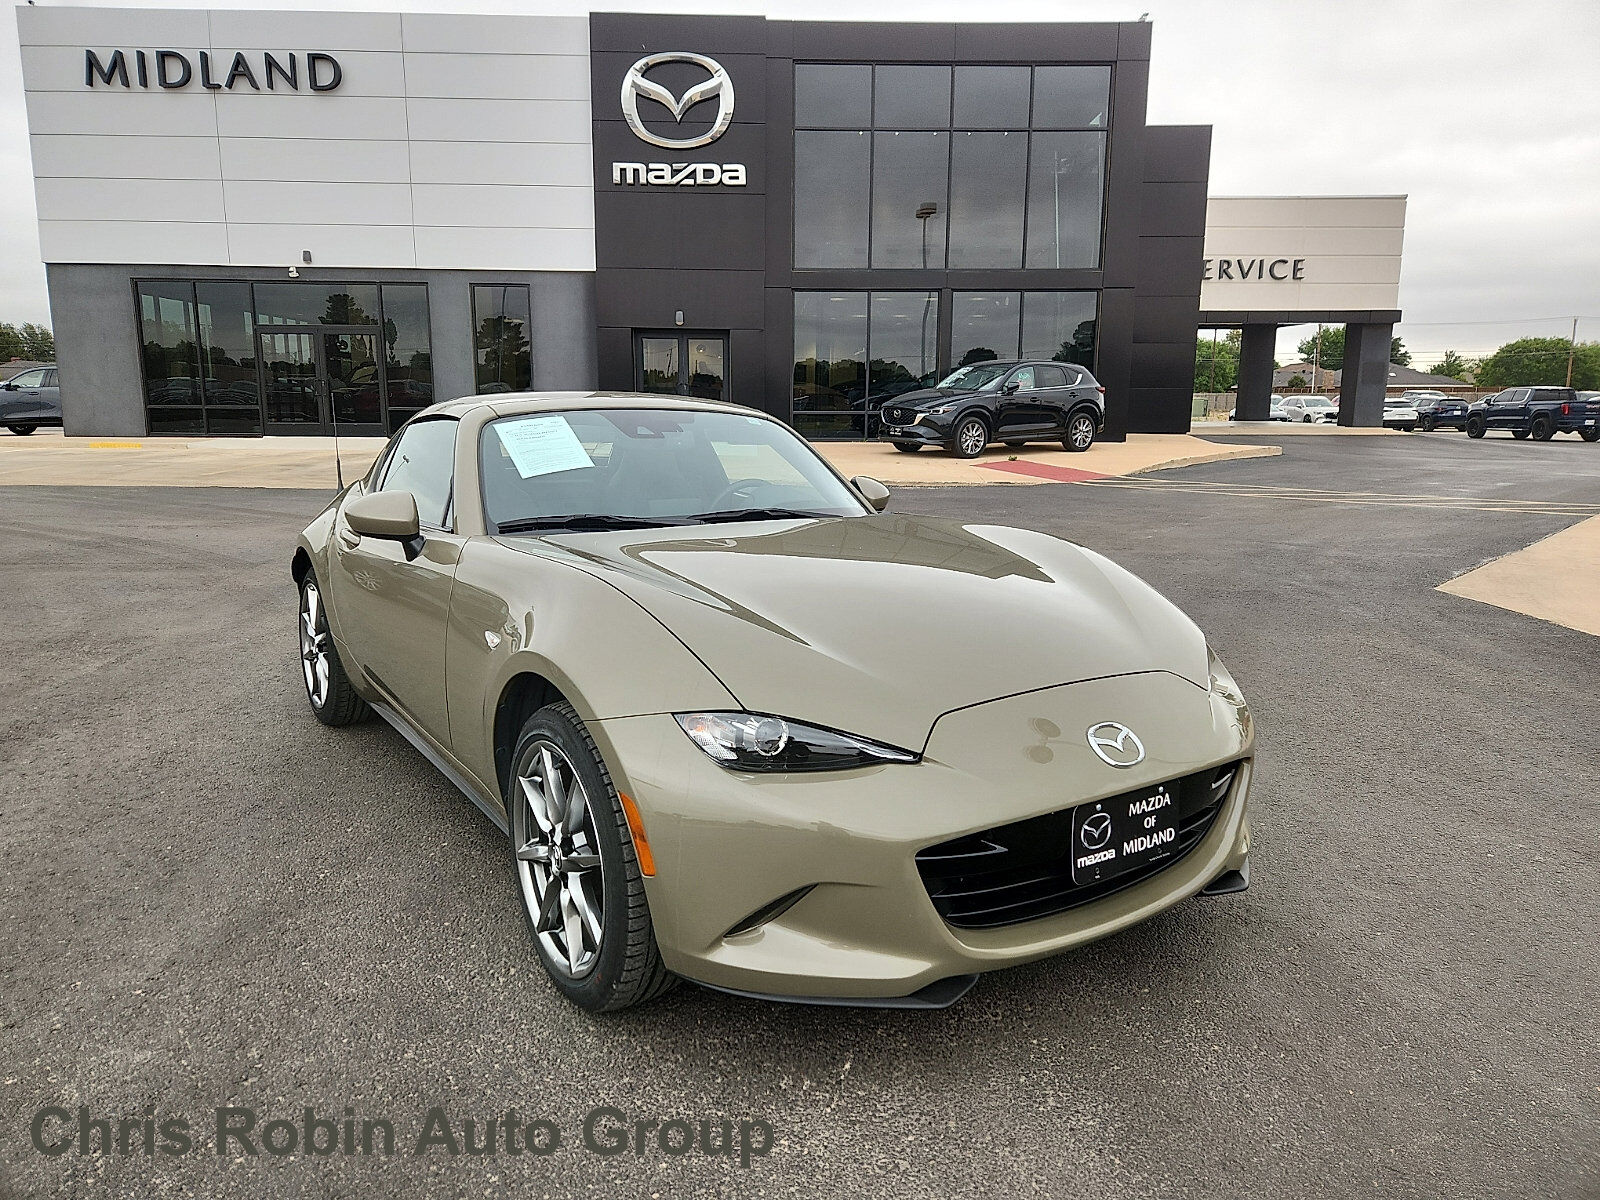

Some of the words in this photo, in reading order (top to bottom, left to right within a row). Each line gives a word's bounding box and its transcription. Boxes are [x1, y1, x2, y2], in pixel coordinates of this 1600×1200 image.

[84, 49, 342, 92] MIDLAND
[612, 161, 748, 187] mazda
[1202, 258, 1305, 280] ERVICE
[1128, 793, 1171, 817] MAZDA
[1143, 815, 1157, 829] OF
[1122, 827, 1176, 856] MIDLAND
[1077, 848, 1116, 869] mazda
